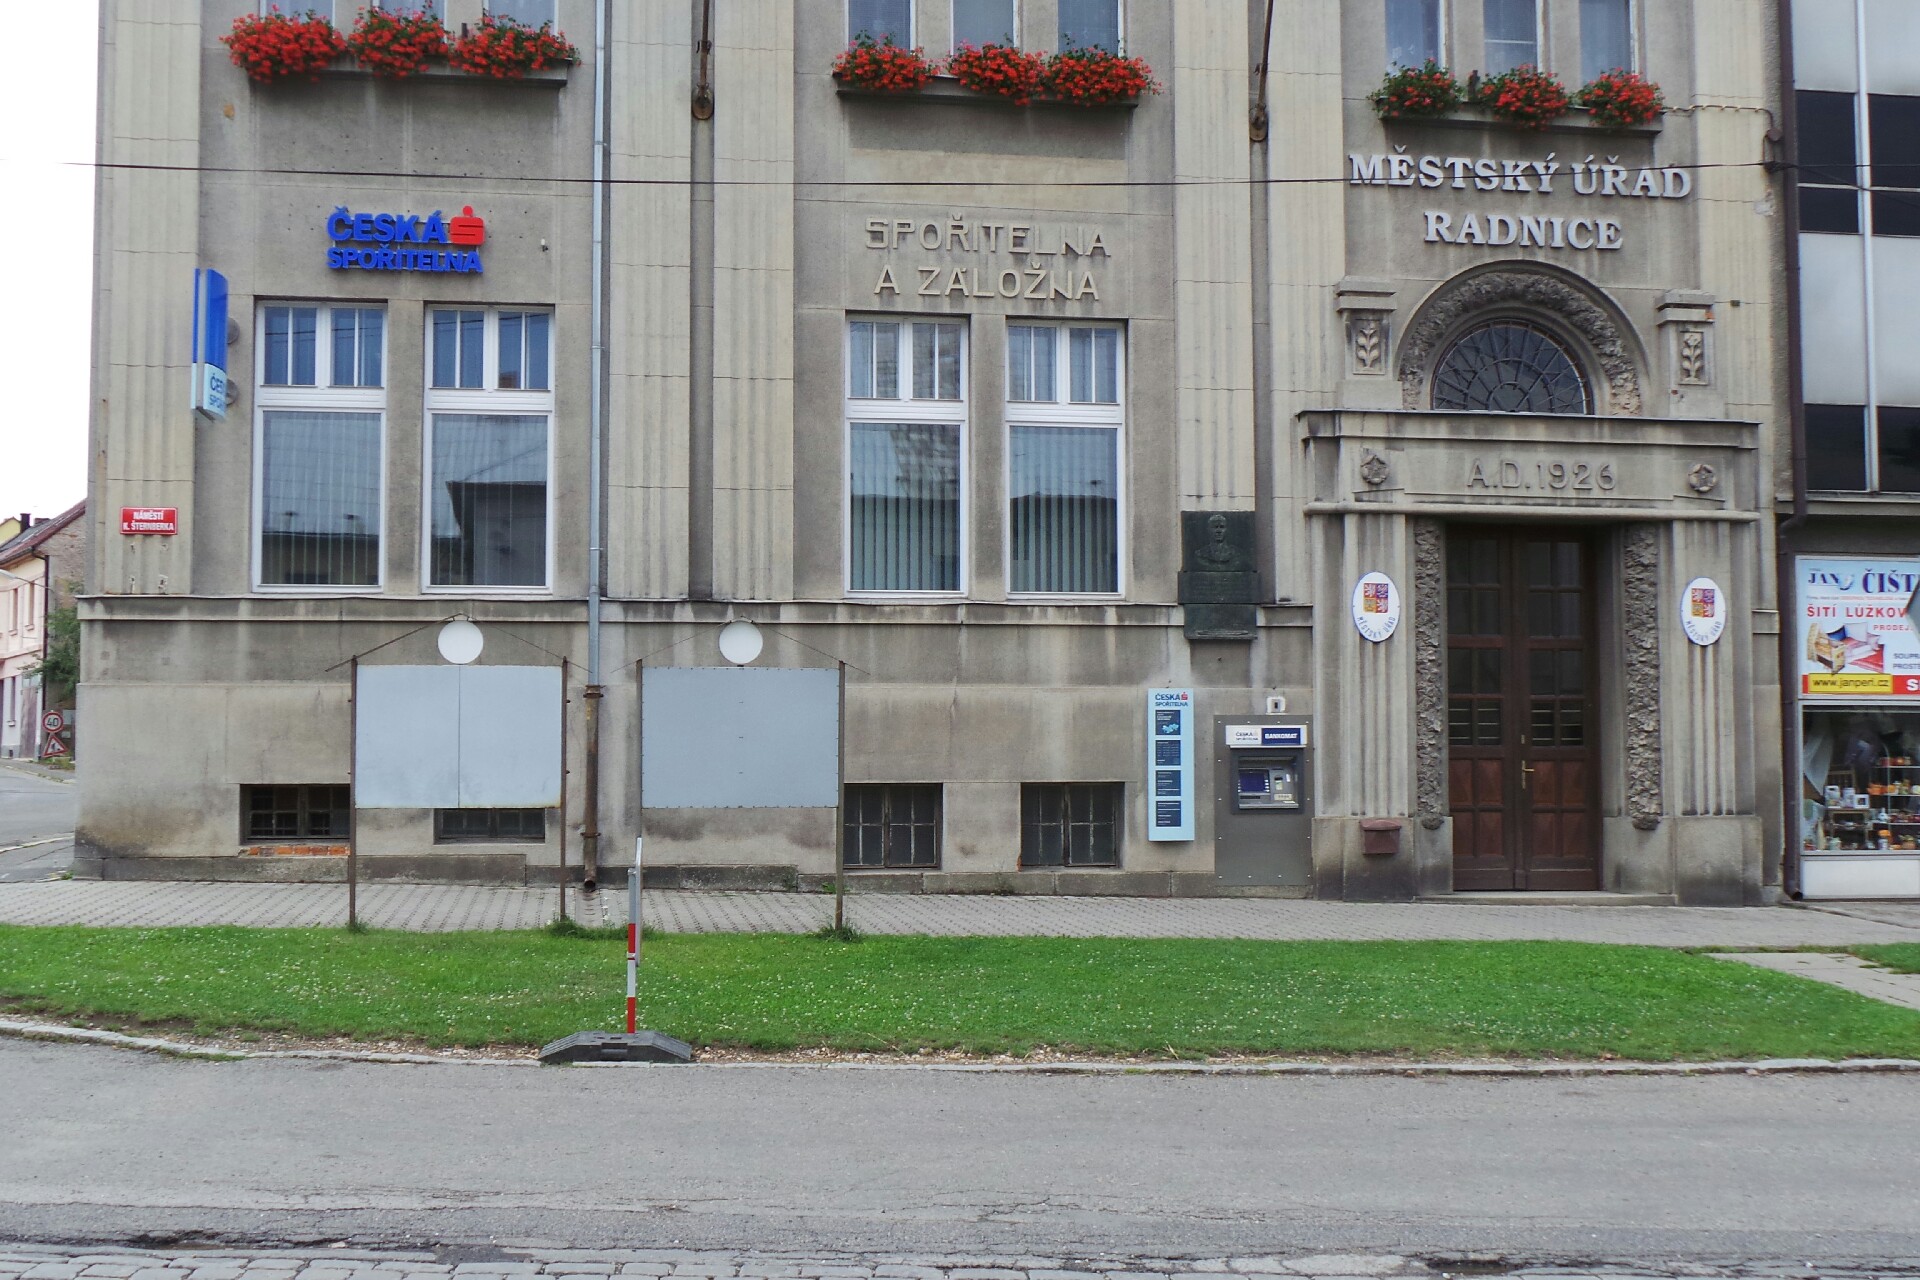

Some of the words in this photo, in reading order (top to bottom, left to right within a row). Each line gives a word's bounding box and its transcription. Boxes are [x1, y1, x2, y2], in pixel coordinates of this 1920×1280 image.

[1349, 145, 1559, 193] MĚSTSKÝ
[1571, 154, 1692, 199] ÚŘAD
[327, 205, 448, 243] ČESKÁ
[865, 212, 1112, 257] SPOŘITELNA
[1424, 210, 1624, 250] RADNICE
[327, 243, 484, 273] SPOŘITELNA
[873, 264, 901, 295] A
[917, 261, 1100, 301] ZÁLOŽNA
[133, 510, 164, 520] NÁMĚSTÍ
[1862, 568, 1920, 593] ČIŠT
[1807, 603, 1837, 617] ŠITÍ
[1155, 692, 1180, 701] ČESKÁ
[47, 717, 59, 727] 40
